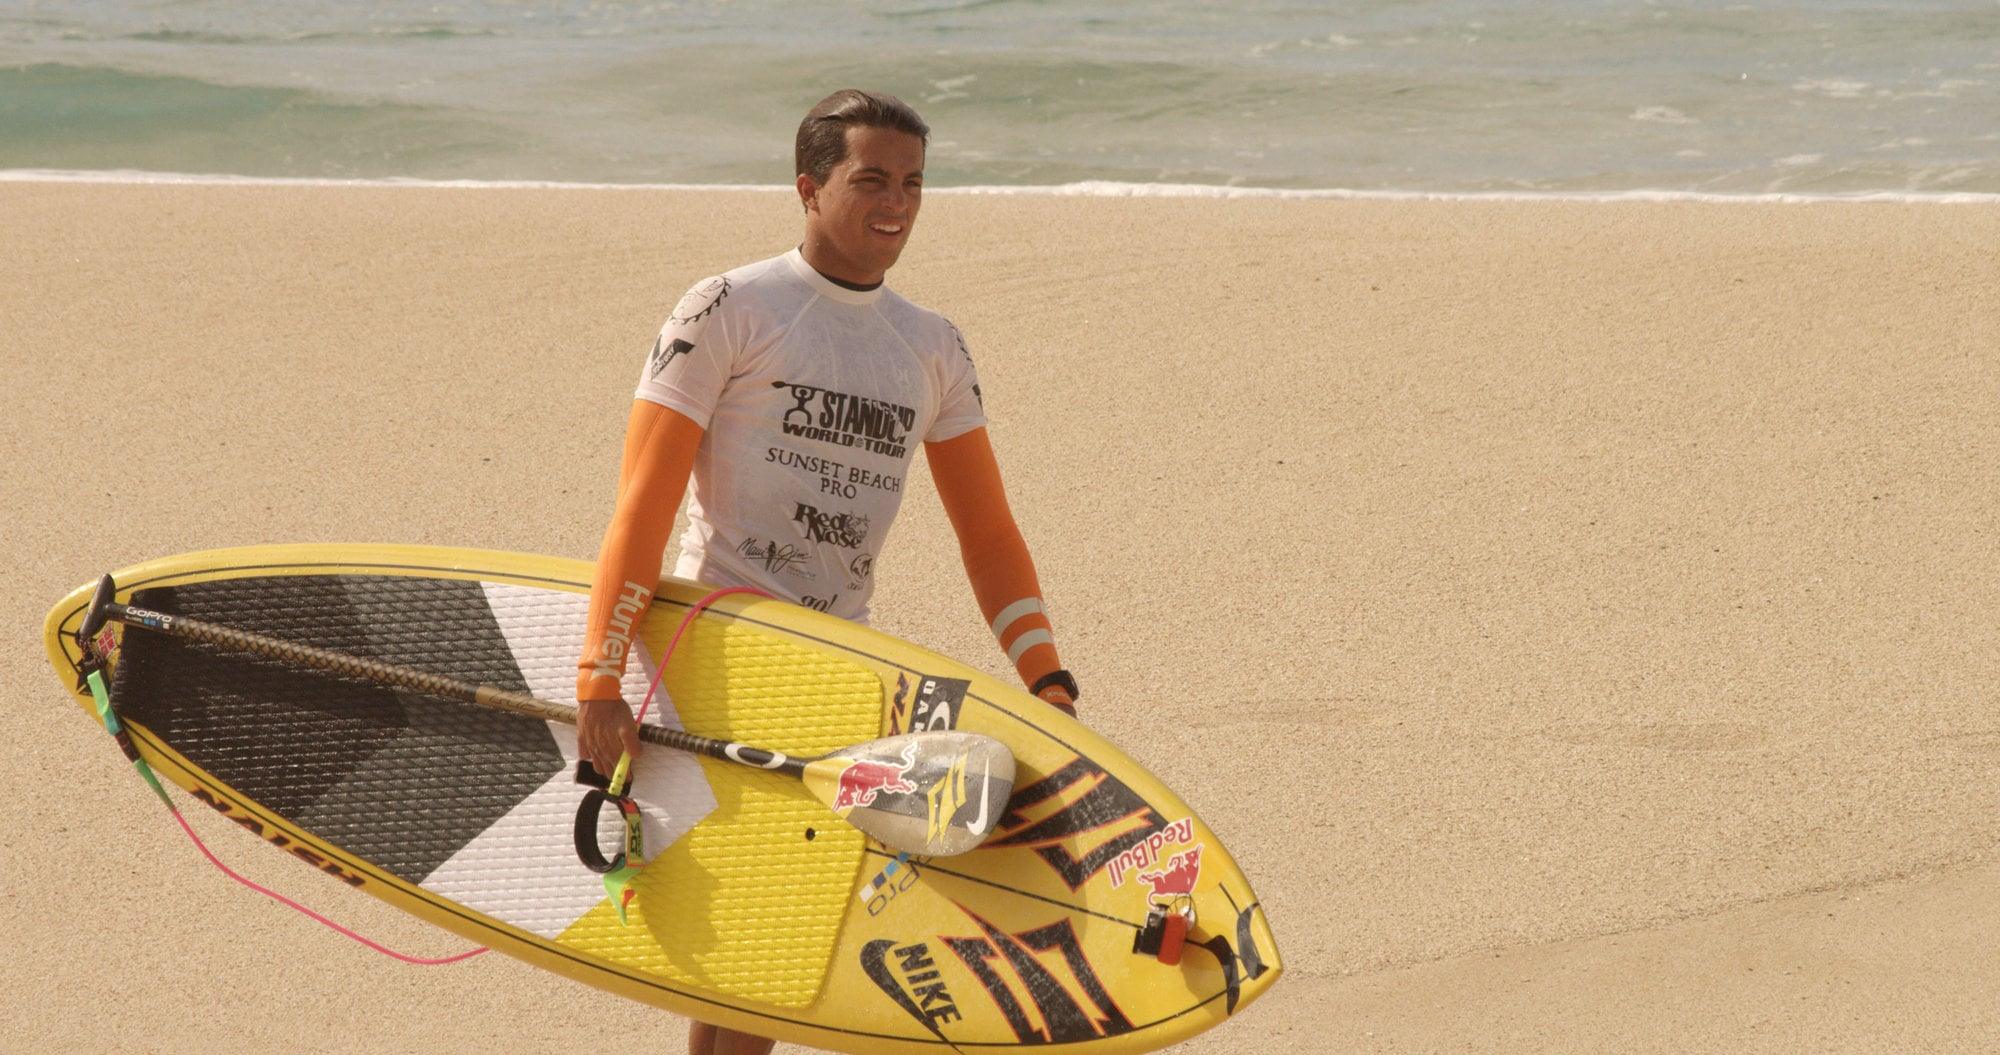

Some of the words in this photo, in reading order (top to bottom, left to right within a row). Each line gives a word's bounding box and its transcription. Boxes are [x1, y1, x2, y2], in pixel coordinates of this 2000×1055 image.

[782, 421, 855, 447] WORLD
[863, 438, 907, 460] TOUR
[764, 447, 844, 479] SUNSET
[848, 467, 901, 493] BEACH
[820, 477, 857, 500] PRO
[792, 501, 851, 531] Red
[803, 519, 862, 549] Nose
[126, 606, 173, 623] GoPro
[590, 579, 651, 682] Hurley
[867, 859, 931, 917] Pro
[893, 942, 963, 1030] NIKE
